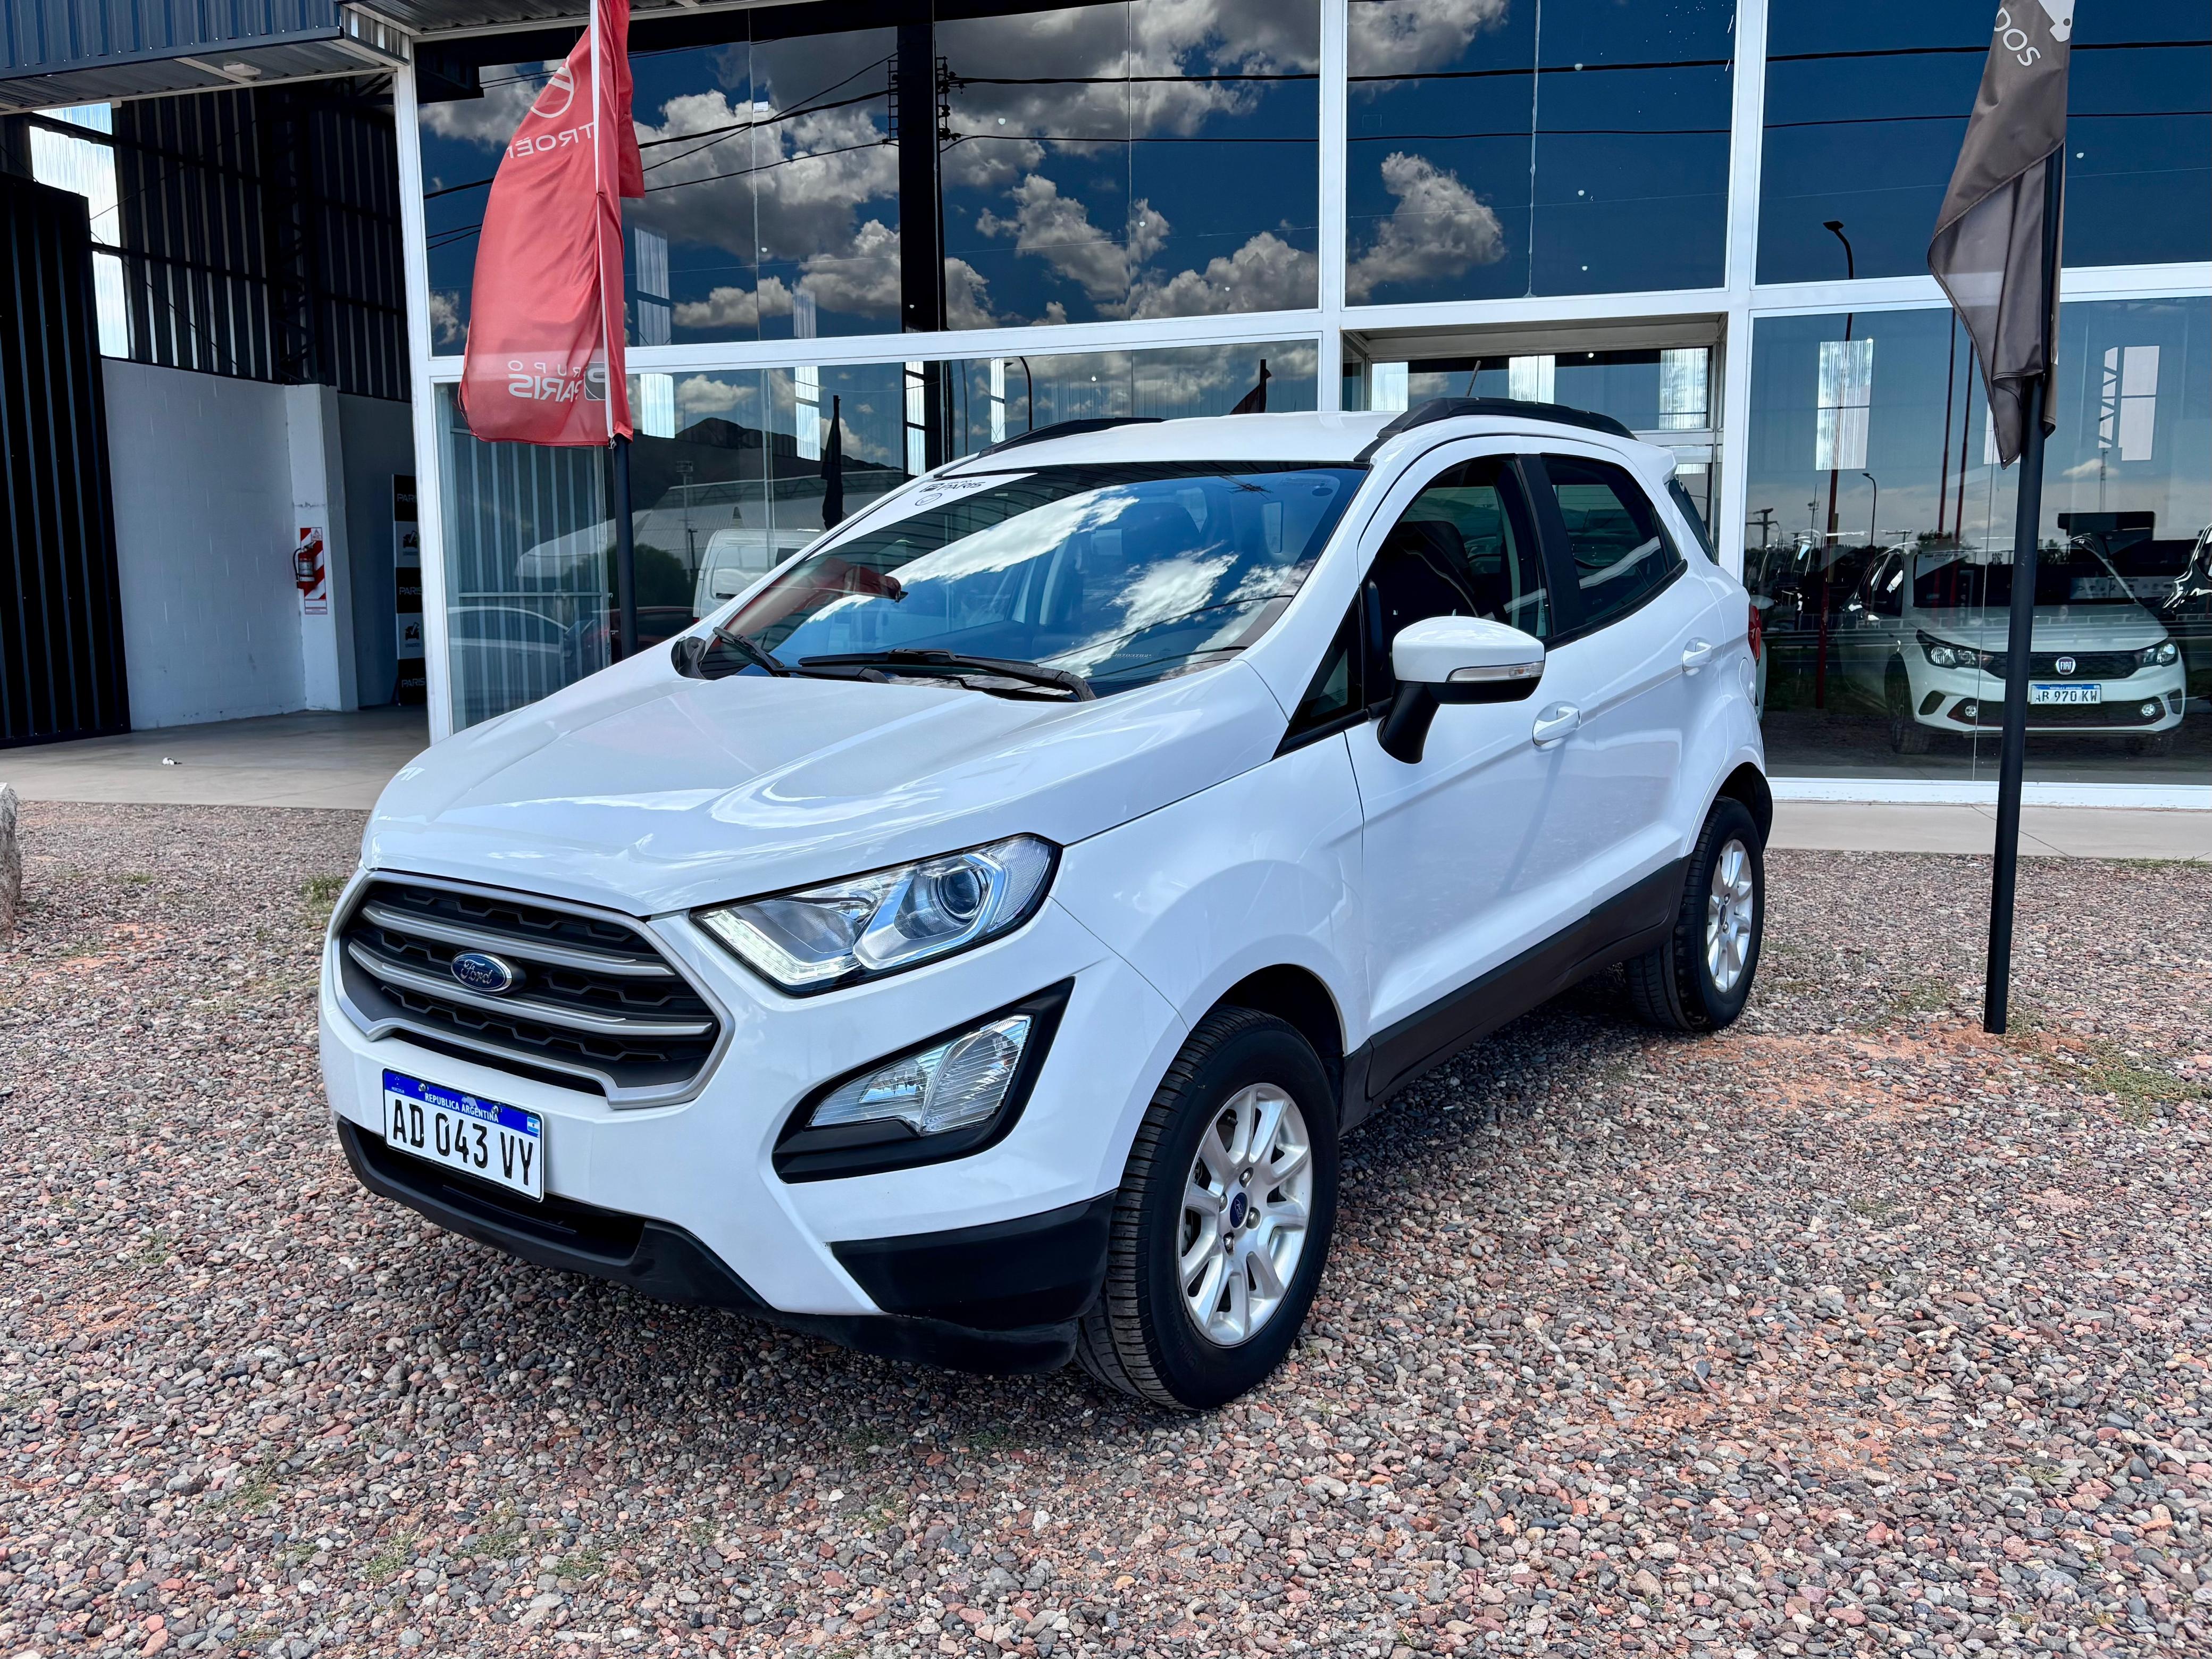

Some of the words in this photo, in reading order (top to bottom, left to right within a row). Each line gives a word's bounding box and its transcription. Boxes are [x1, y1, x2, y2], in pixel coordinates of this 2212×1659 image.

[2060, 661, 2072, 671] FIAT
[401, 677, 426, 688] PARIS
[2055, 691, 2077, 702] 970
[2082, 690, 2097, 702] KW
[460, 959, 493, 984] Ford
[424, 1092, 460, 1111] REPUBLICA
[461, 1103, 499, 1123] ARGENTINA
[393, 1099, 424, 1149] AD
[435, 1112, 488, 1169] 043
[500, 1132, 533, 1186] VY
